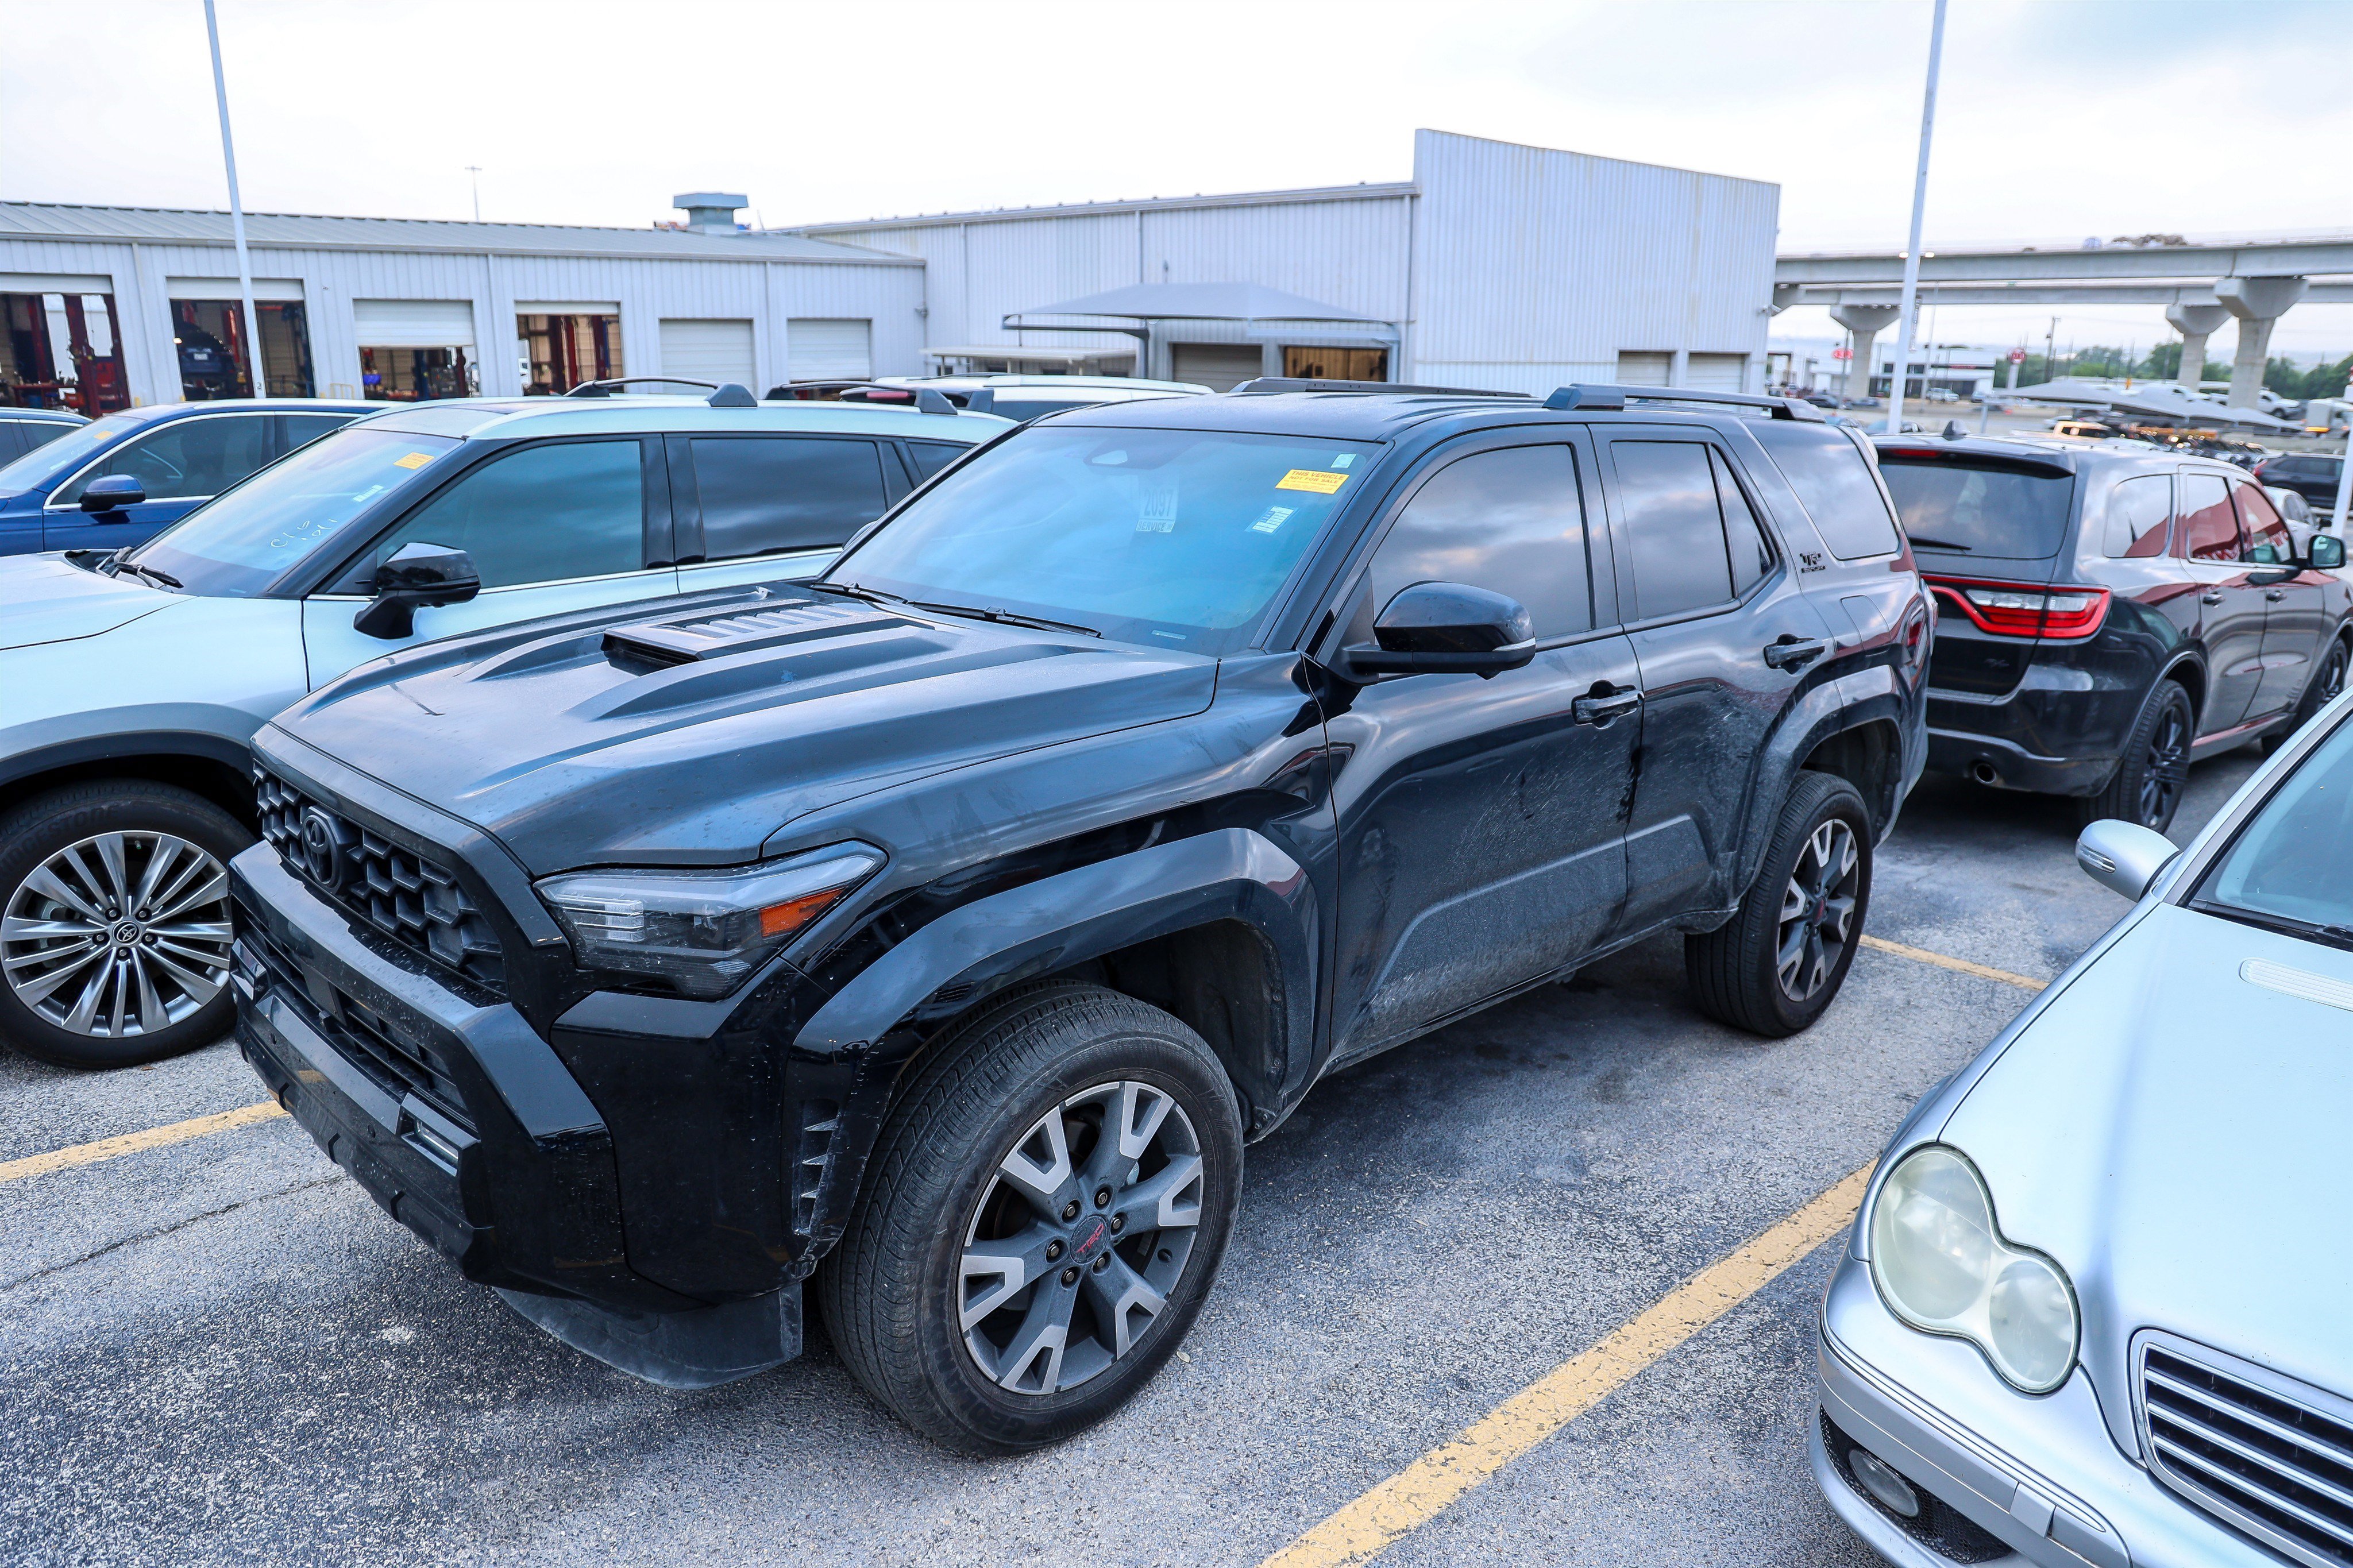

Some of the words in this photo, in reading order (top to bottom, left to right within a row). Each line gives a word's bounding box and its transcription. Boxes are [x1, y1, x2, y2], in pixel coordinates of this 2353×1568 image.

[1311, 472, 1345, 480] VEHICLE
[1143, 488, 1174, 517] 2097
[1136, 521, 1167, 532] SERVICE
[1075, 1222, 1105, 1254] TRD
